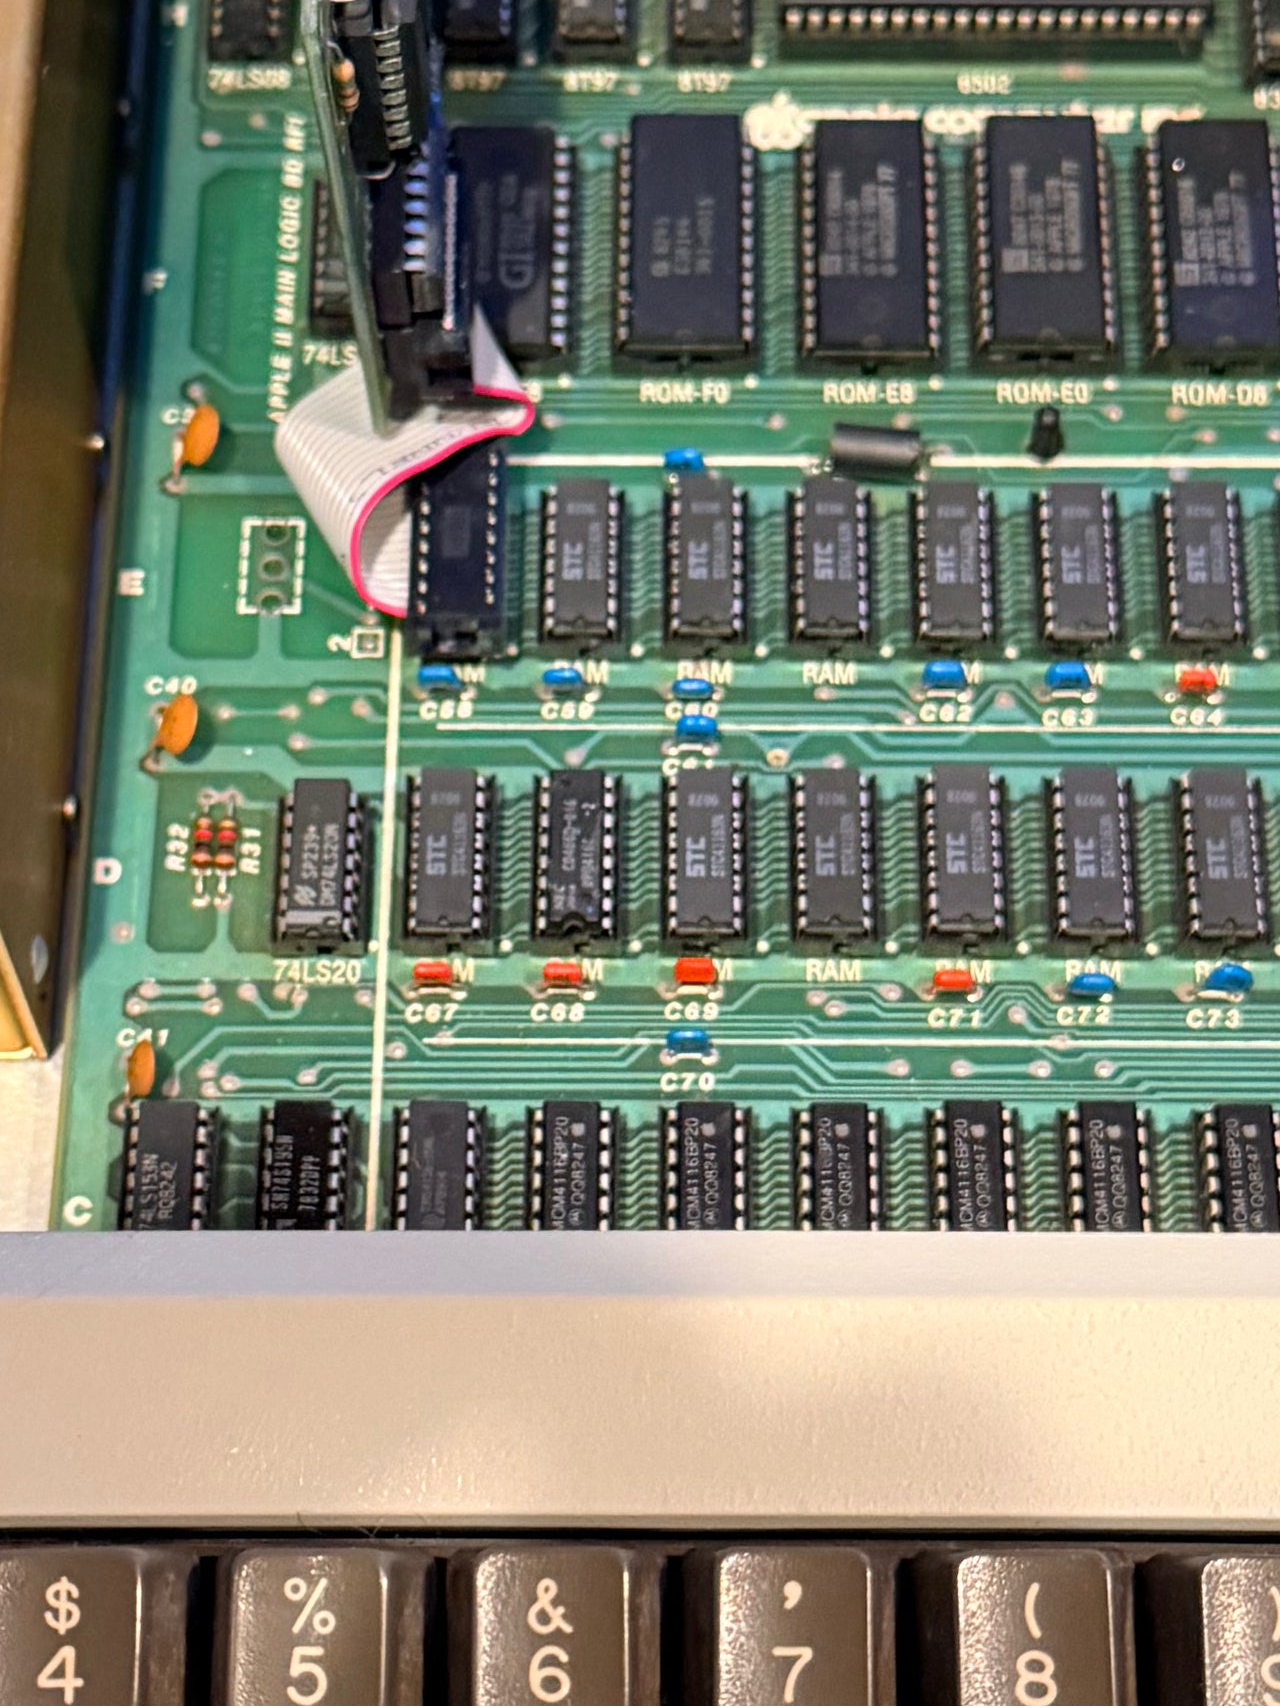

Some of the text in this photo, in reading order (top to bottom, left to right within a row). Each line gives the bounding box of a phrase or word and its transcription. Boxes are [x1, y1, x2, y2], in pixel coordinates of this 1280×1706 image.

[277, 197, 303, 263] LOGIC
[274, 269, 297, 325] MAIN
[640, 382, 731, 404] ROM-F0
[996, 381, 1092, 405] ROM-E0
[120, 571, 144, 595] E
[145, 677, 197, 694] C40
[802, 663, 855, 685] RAM
[919, 703, 973, 721] C62
[164, 823, 188, 871] R32
[240, 827, 262, 874] R31
[95, 859, 122, 884] D
[274, 962, 361, 984] 74LS20
[806, 962, 861, 984] RAM
[405, 1003, 457, 1022] C67
[928, 1009, 981, 1027] C71
[1056, 1007, 1110, 1026] C72
[659, 1073, 715, 1092] C70
[64, 1196, 91, 1224] C
[44, 1576, 82, 1636] $
[283, 1576, 336, 1636] %
[526, 1577, 574, 1635] &
[1023, 1581, 1042, 1639] (
[36, 1644, 85, 1705] 4
[285, 1645, 328, 1706] 5
[528, 1644, 572, 1704] 6
[771, 1645, 815, 1704] 7
